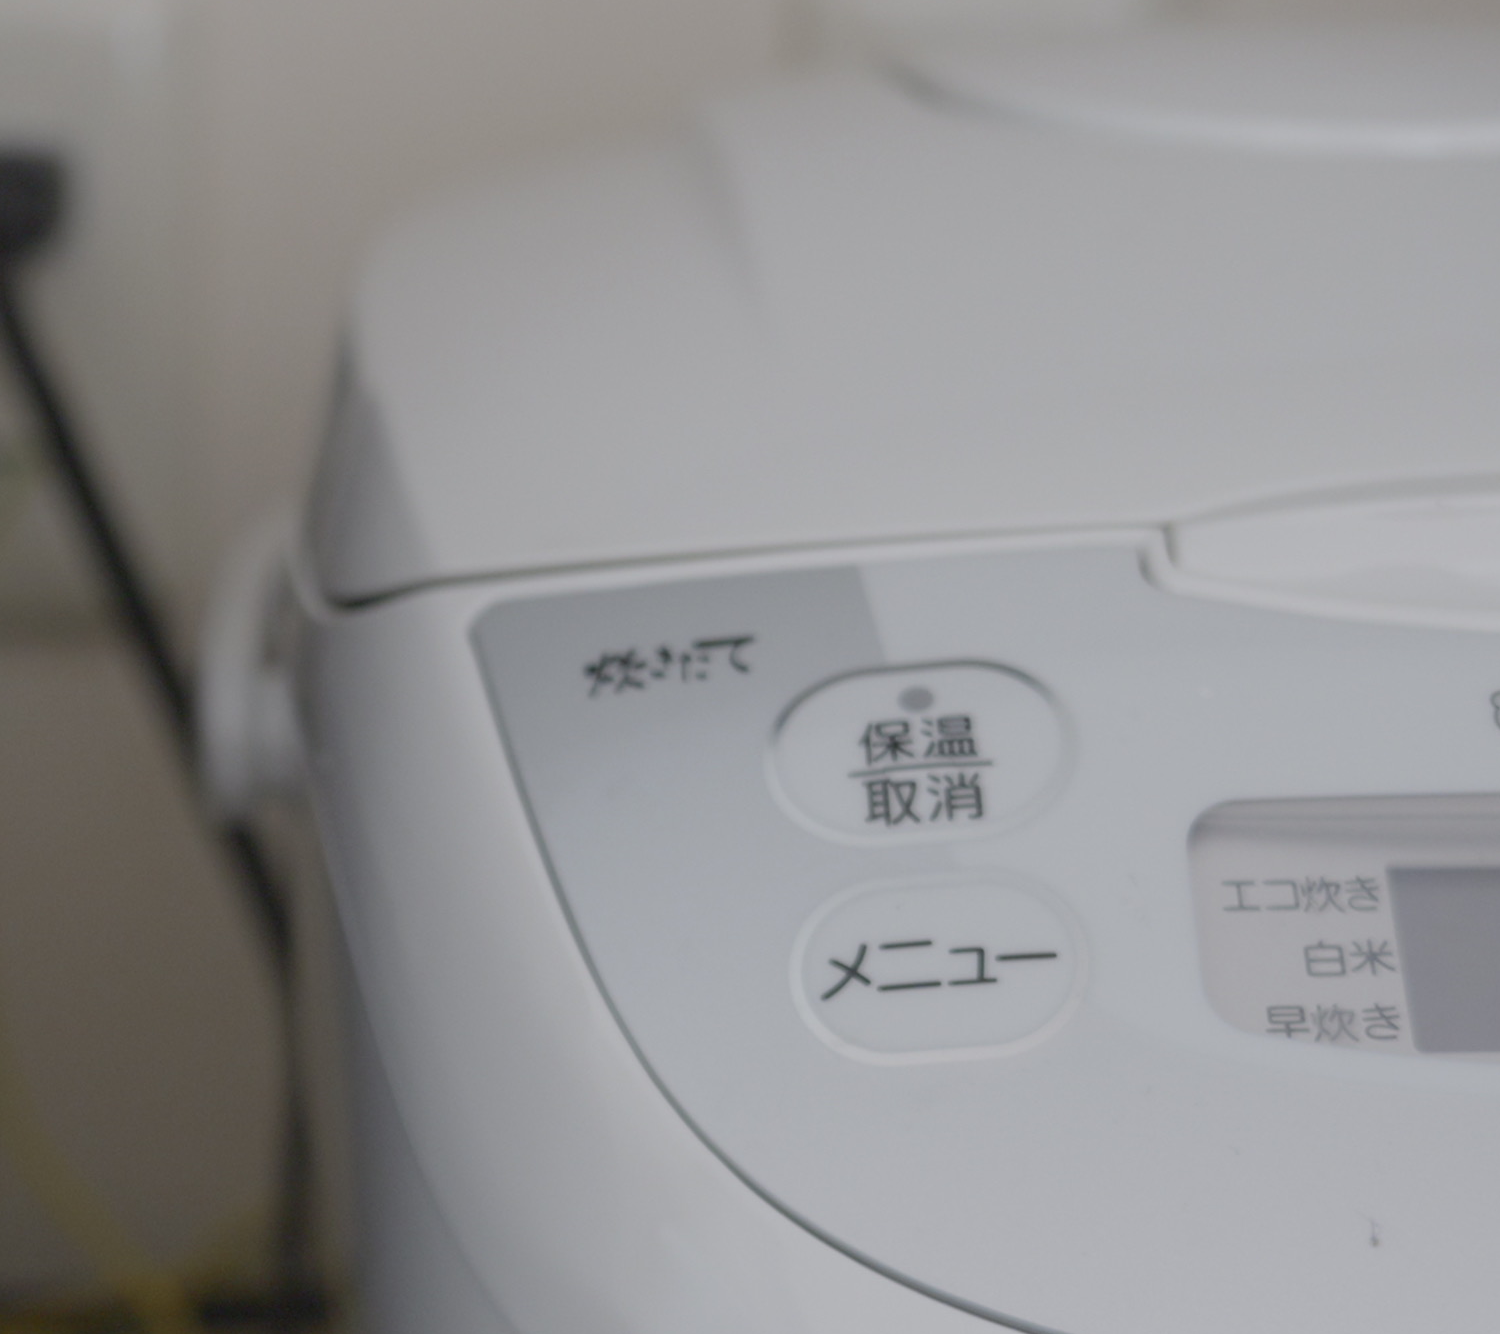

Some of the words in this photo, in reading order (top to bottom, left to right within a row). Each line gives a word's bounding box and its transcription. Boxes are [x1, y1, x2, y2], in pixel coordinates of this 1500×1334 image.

[856, 713, 982, 763] 保温
[862, 771, 986, 829] 取消
[1222, 874, 1381, 914] エコ炊き
[820, 938, 1059, 1002] メニュー
[1302, 935, 1398, 981] 白米
[1262, 999, 1404, 1047] 早炊き
